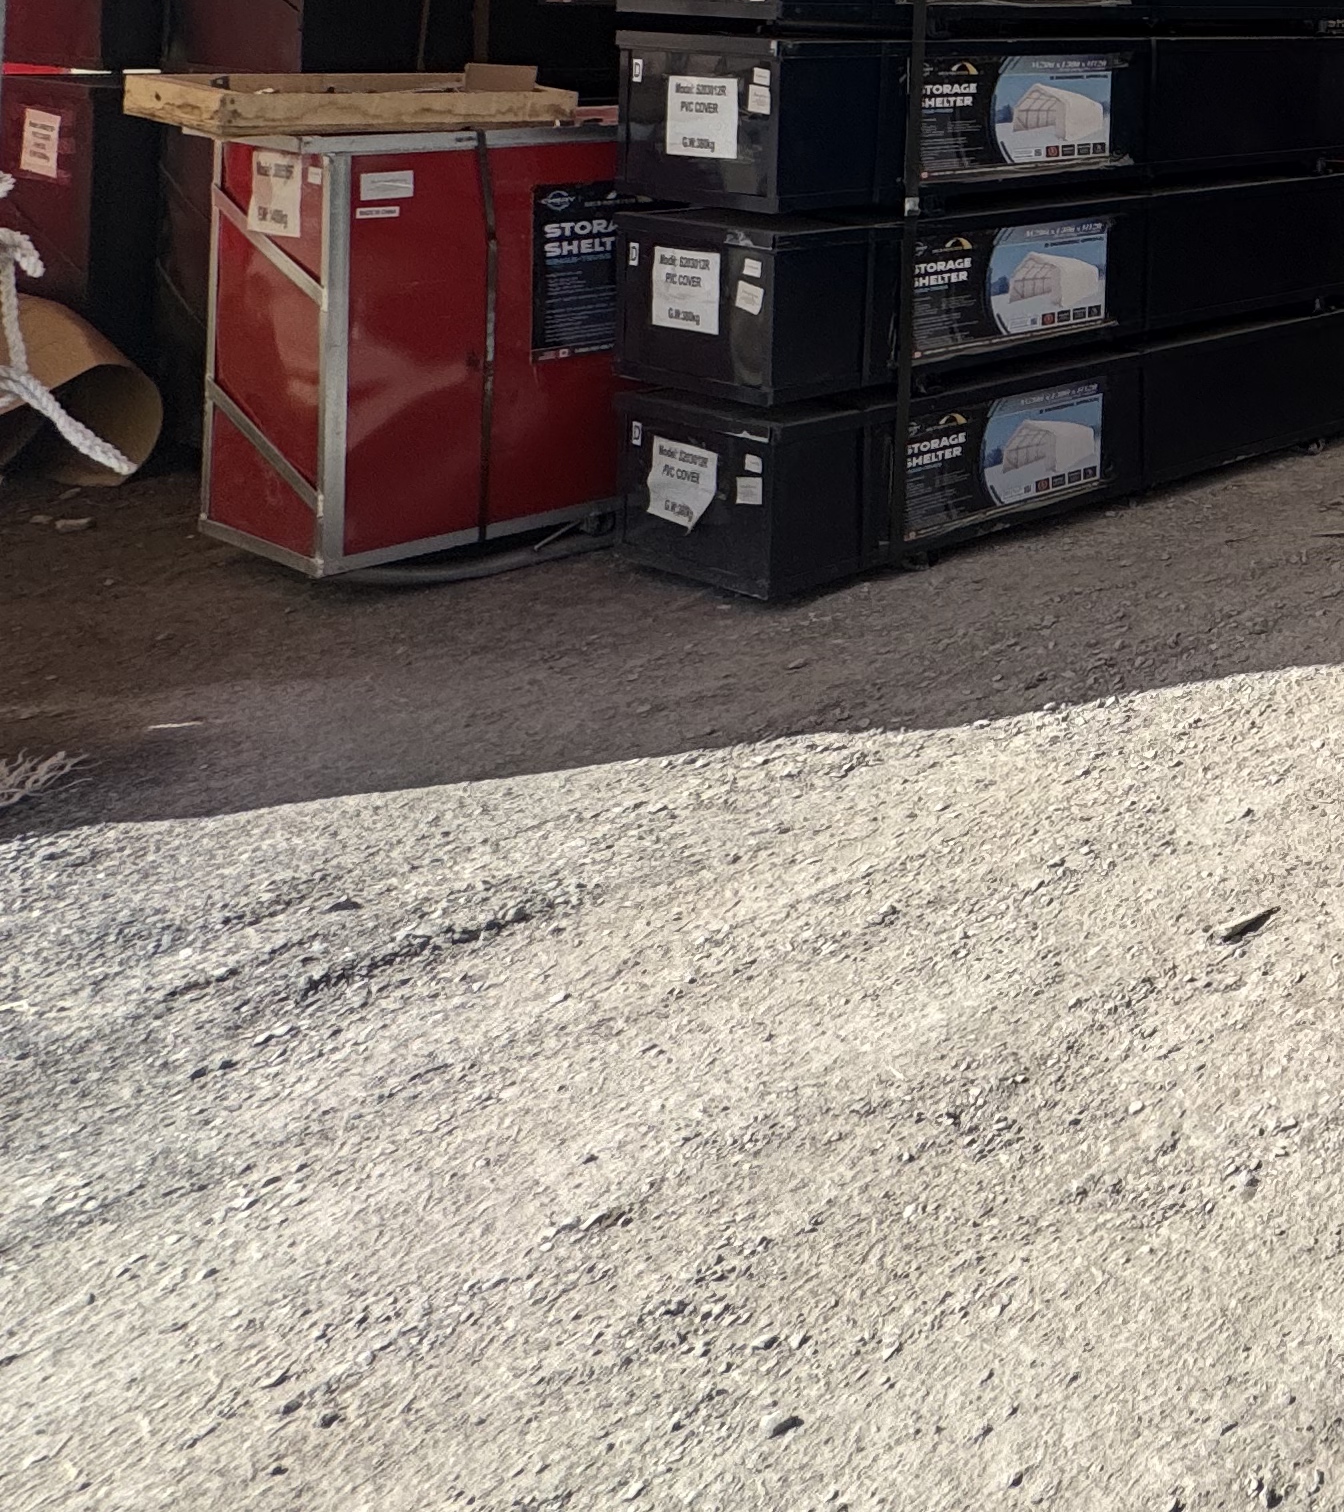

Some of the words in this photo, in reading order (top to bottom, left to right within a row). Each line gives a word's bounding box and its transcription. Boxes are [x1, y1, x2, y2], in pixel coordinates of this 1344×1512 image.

[695, 102, 719, 114] COVER
[543, 219, 618, 238] STORA
[544, 237, 616, 257] SHELT
[678, 274, 702, 287] COVER
[676, 469, 700, 484] COVER
